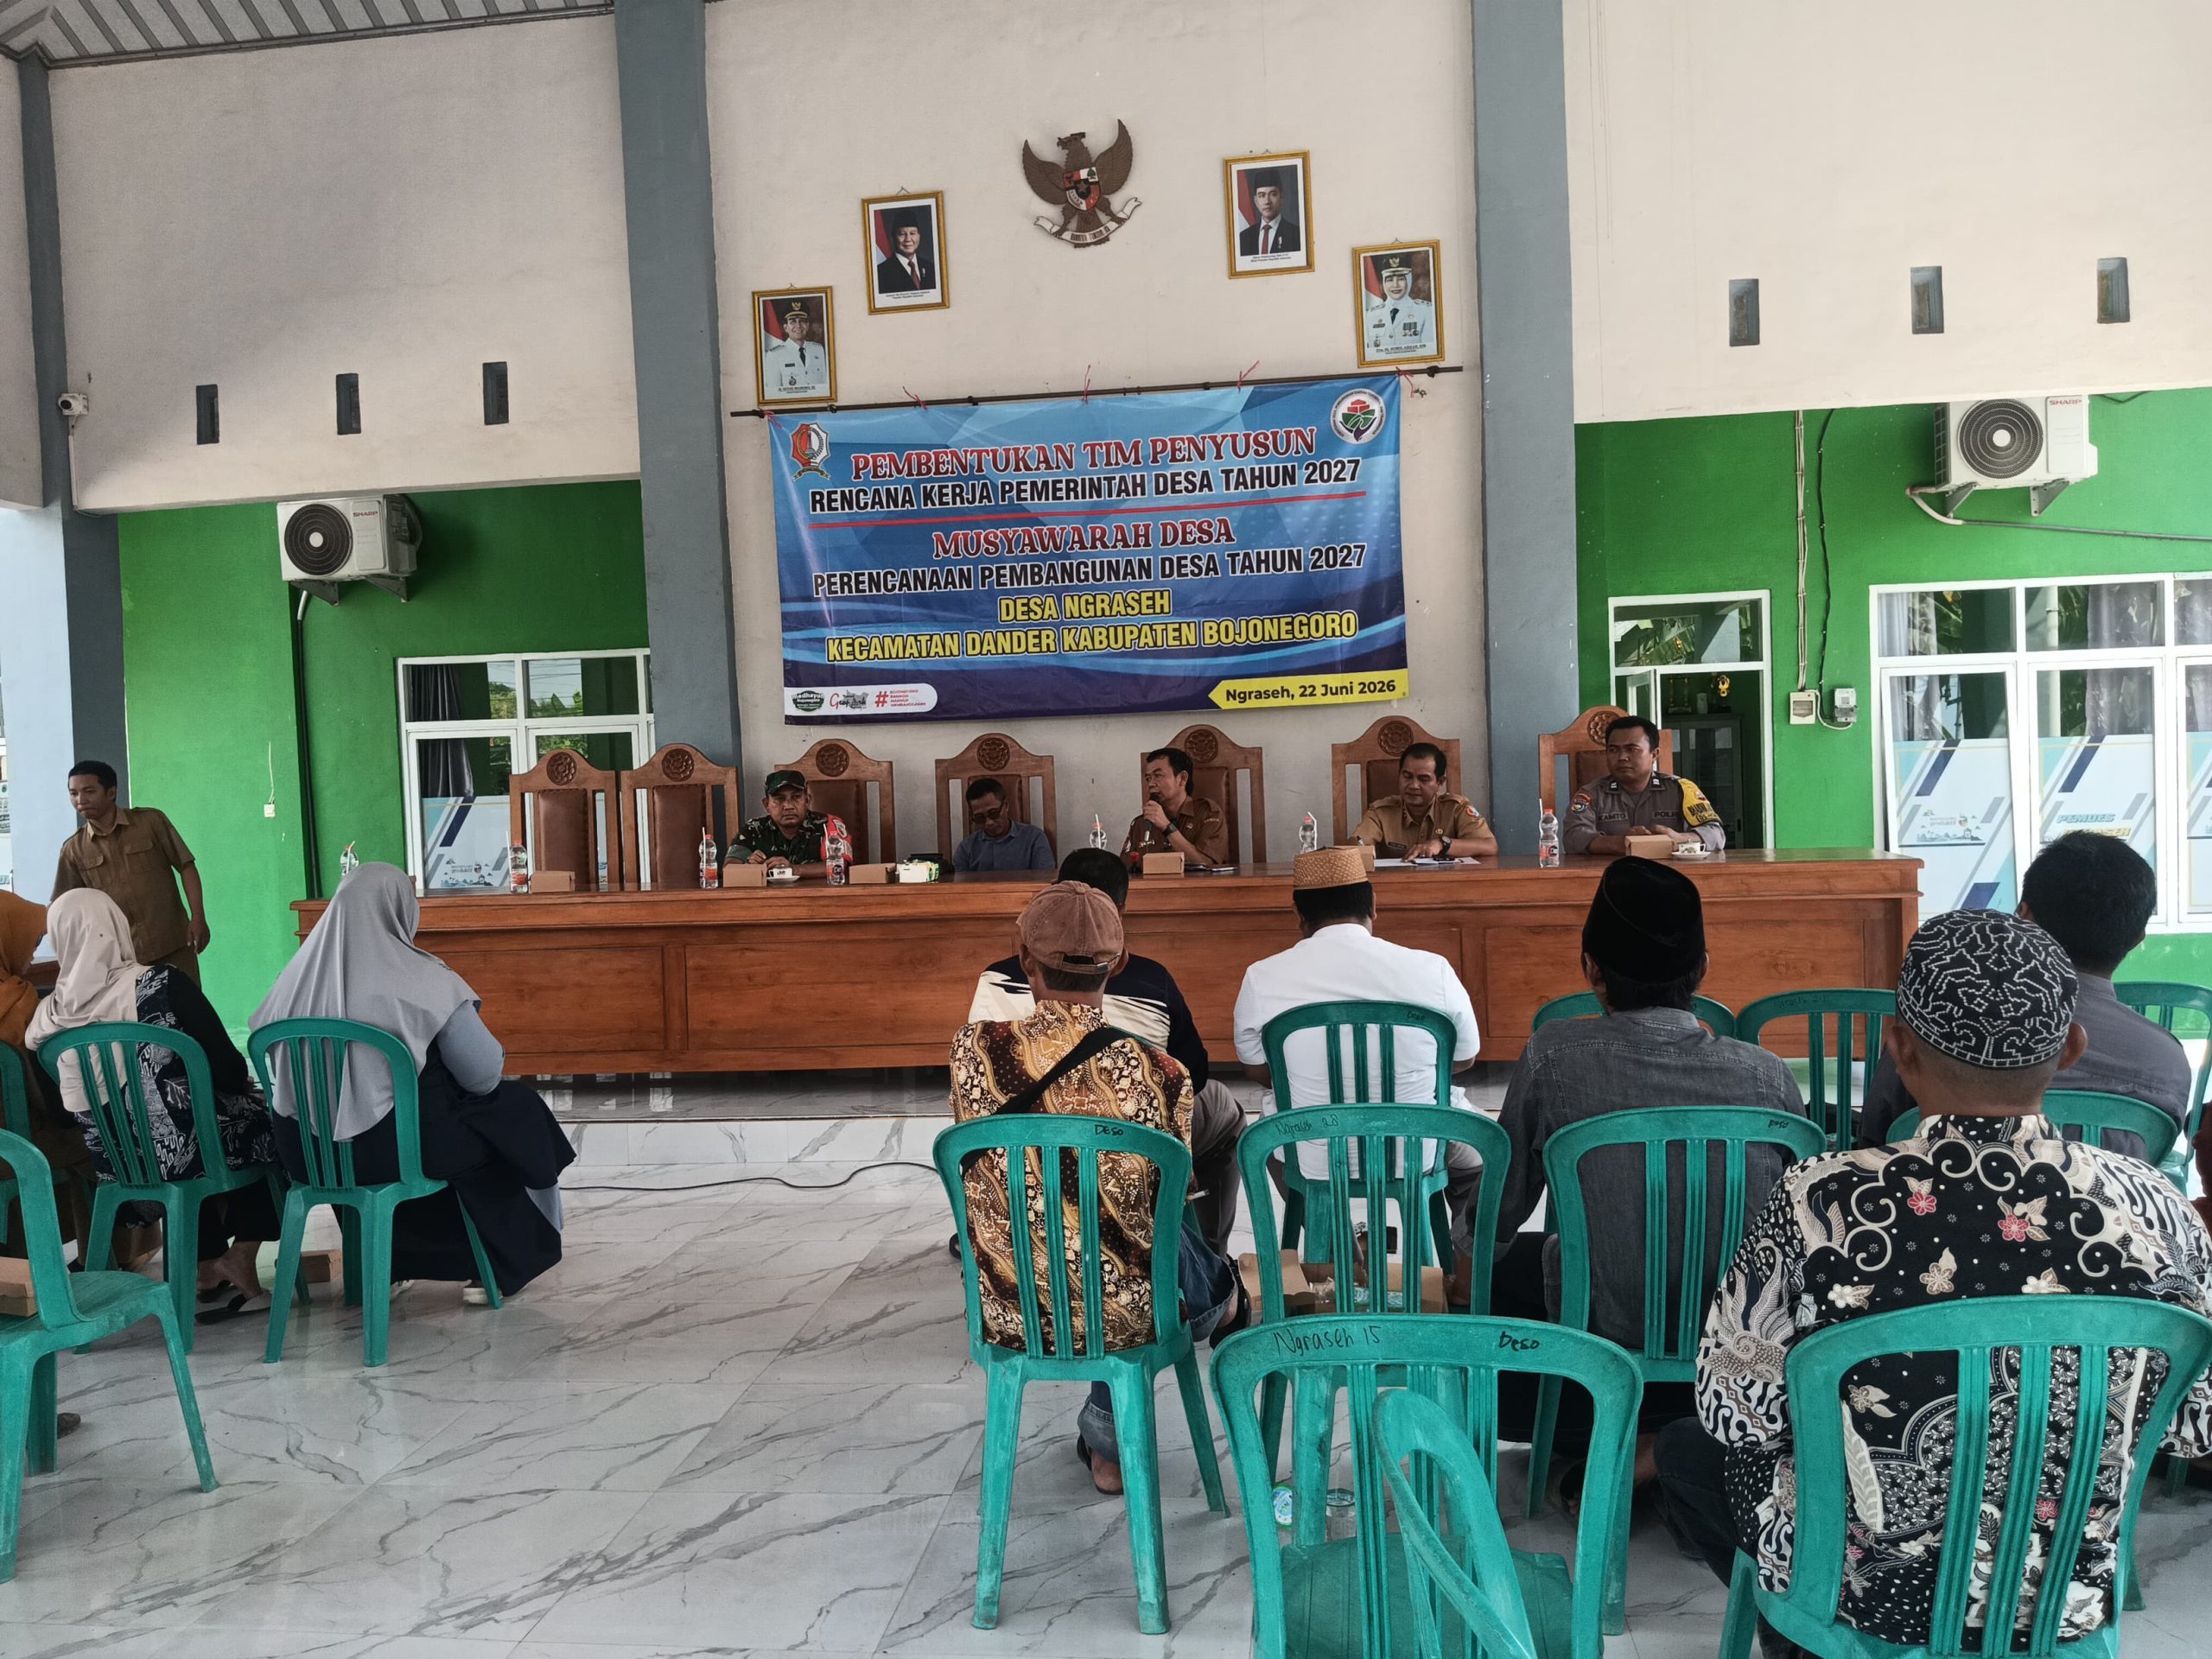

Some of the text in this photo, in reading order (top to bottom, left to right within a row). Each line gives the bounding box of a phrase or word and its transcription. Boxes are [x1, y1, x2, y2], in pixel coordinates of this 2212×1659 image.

[851, 427, 1316, 480] PEMBENTUKAN TIM PENYUSUN
[810, 458, 1362, 513] RENCANA KERJA PEMERINTAH DESA TAHUN 2027
[932, 518, 1236, 559] MUSYAWARAH DESA
[813, 543, 1367, 597] PERENCANAAN PEMBANGUNAN DESA TAHUN 2027
[999, 589, 1172, 623] DESA NGRASEH
[827, 610, 1358, 663] KECAMATAN DANDER KABUPATEN BOJONEGORO
[1225, 679, 1396, 703] Ngraseh, 22 Juni 2026
[1273, 1325, 1381, 1357] Ngraseh 15
